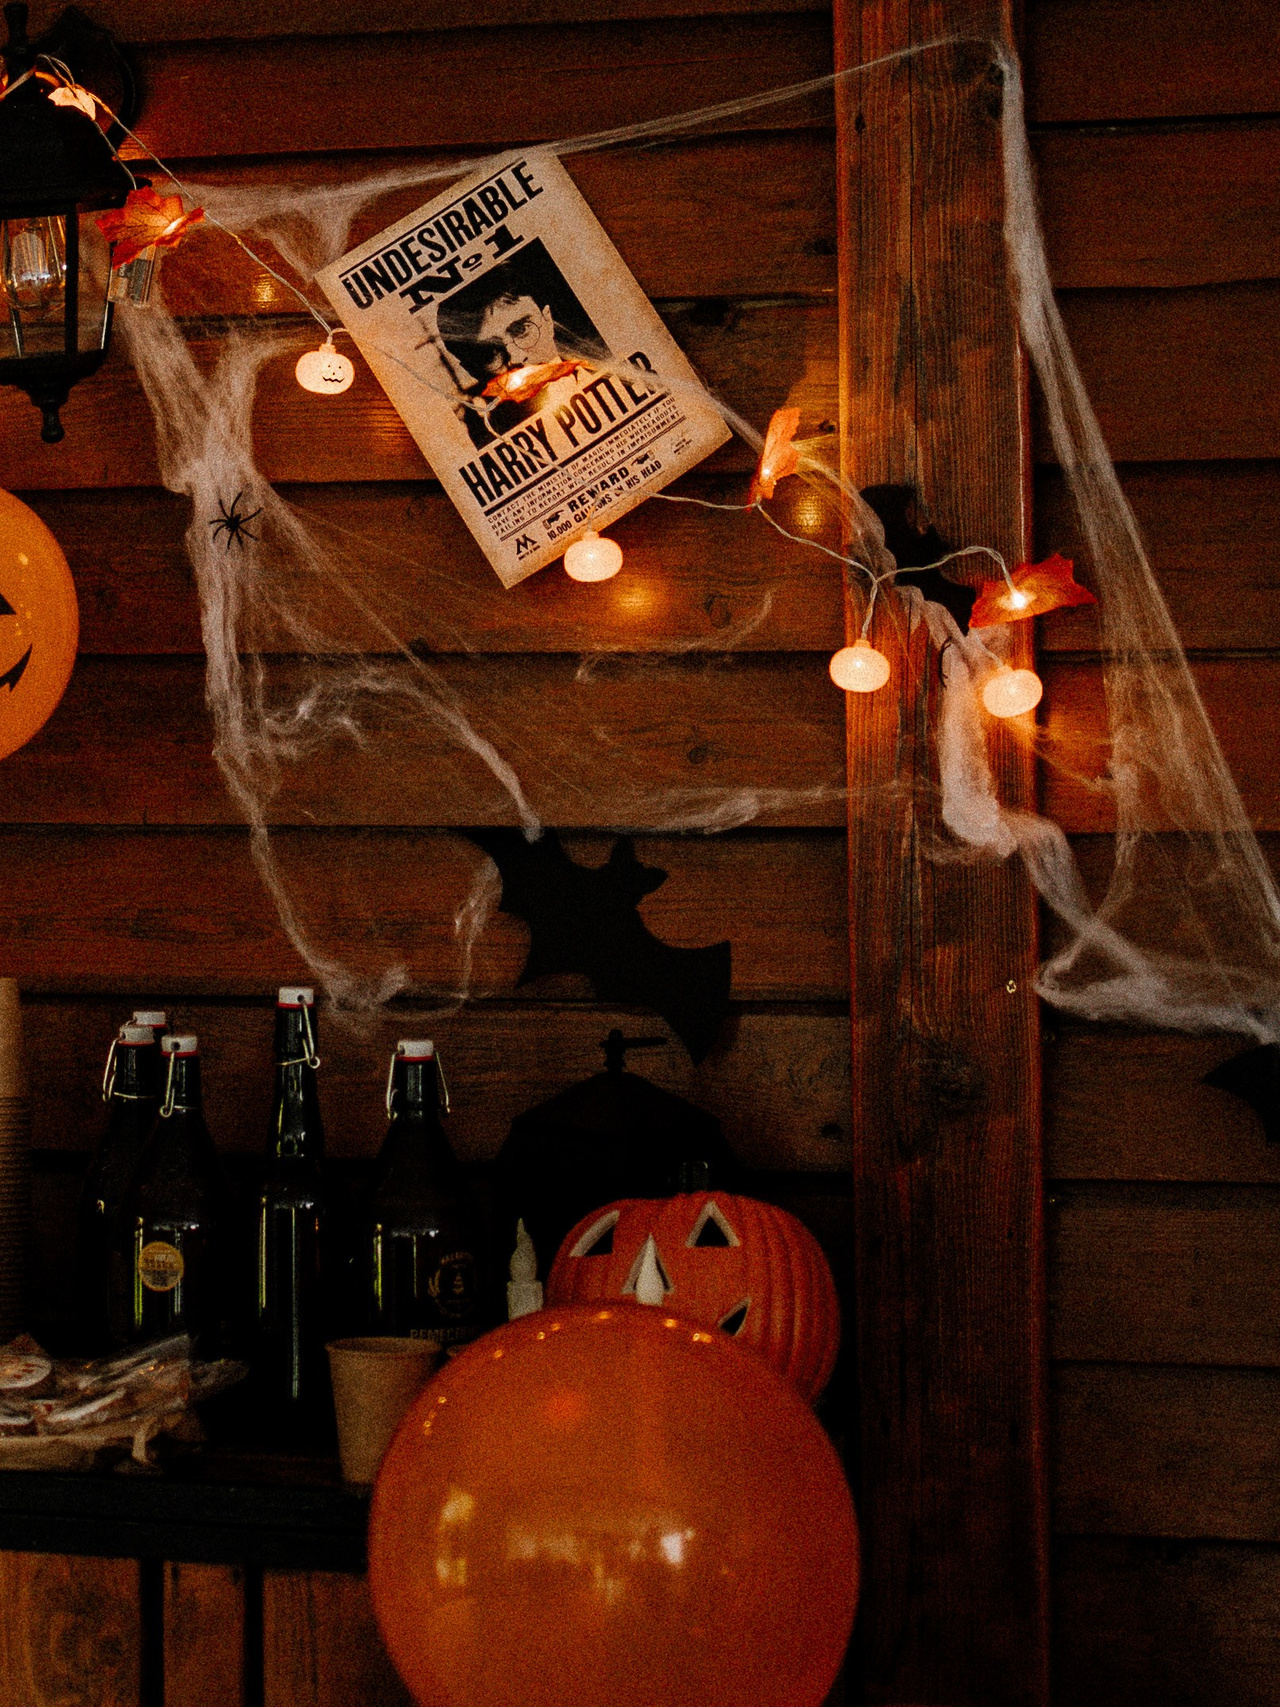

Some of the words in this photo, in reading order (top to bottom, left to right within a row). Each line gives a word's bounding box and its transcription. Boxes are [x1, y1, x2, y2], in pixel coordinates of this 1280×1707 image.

[340, 160, 544, 310] UNDESIRABLE
[458, 418, 558, 507] HARRY
[487, 500, 519, 523] CONTACT
[522, 491, 535, 501] THE
[581, 446, 603, 462] MAGIC
[605, 412, 651, 446] IMMEDIATELY
[661, 397, 675, 407] YOU
[491, 516, 508, 529] HAVE
[512, 506, 524, 516] ANY
[526, 476, 572, 507] INFORMATION
[573, 448, 614, 477] CONCERNING
[615, 438, 627, 448] HIS
[628, 404, 676, 439] WHEREABOUTS
[495, 515, 524, 536] FAILING
[527, 507, 537, 515] TO
[538, 488, 564, 508] REPORT
[567, 476, 585, 489] WIL
[587, 455, 614, 476] RESULT
[567, 466, 629, 512] REWARD
[625, 475, 640, 488] HIS
[640, 460, 661, 478] HEAD
